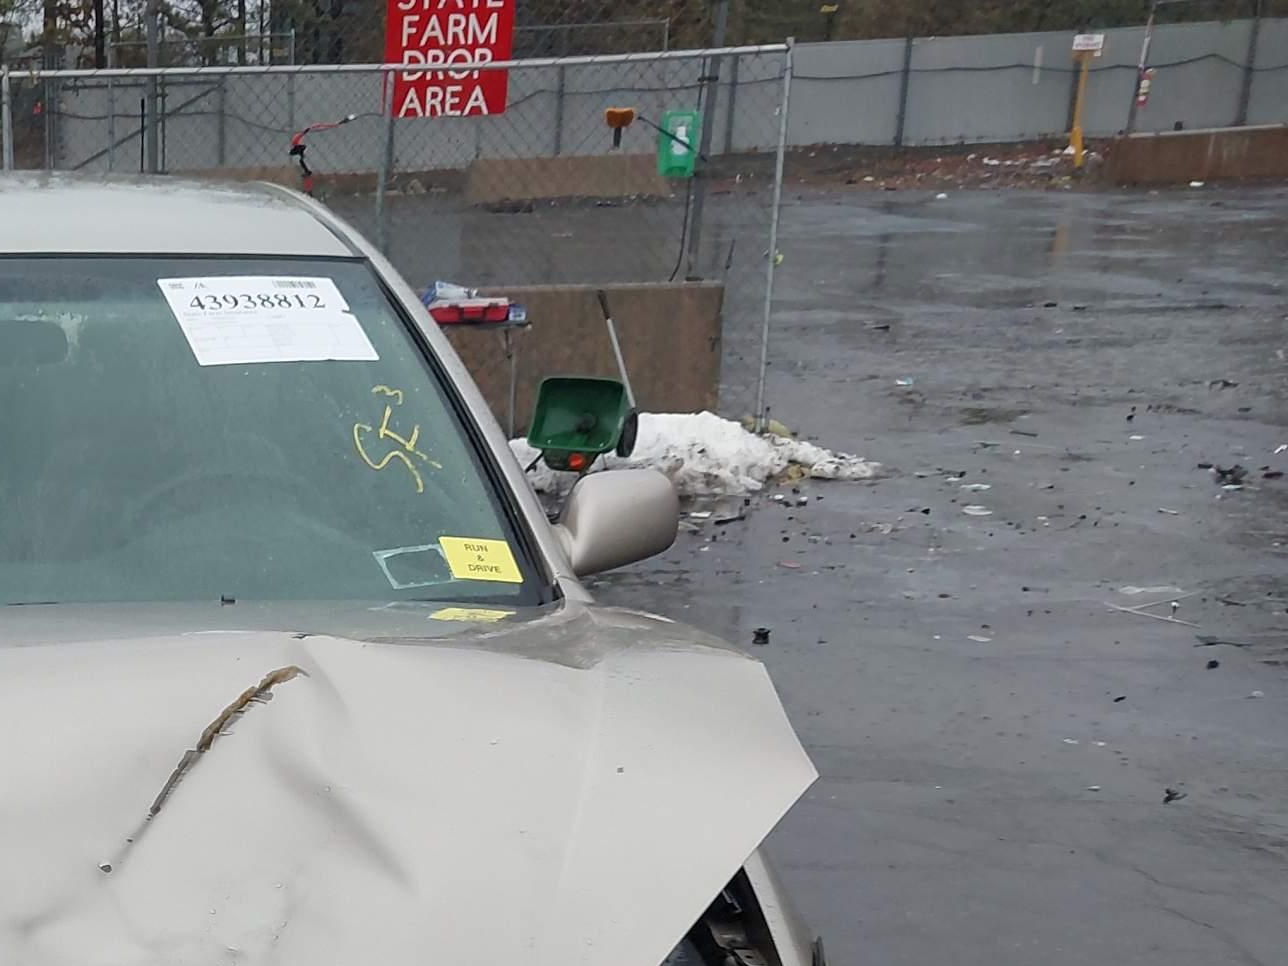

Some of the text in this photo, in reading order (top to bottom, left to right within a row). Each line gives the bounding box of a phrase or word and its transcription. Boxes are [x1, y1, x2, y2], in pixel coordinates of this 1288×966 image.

[401, 12, 498, 47] FARM
[401, 47, 493, 81] DROP
[398, 84, 489, 118] AREA
[190, 294, 326, 311] 43938812
[464, 543, 488, 553] RUN
[477, 554, 485, 562] &
[468, 563, 502, 574] DRIVE
